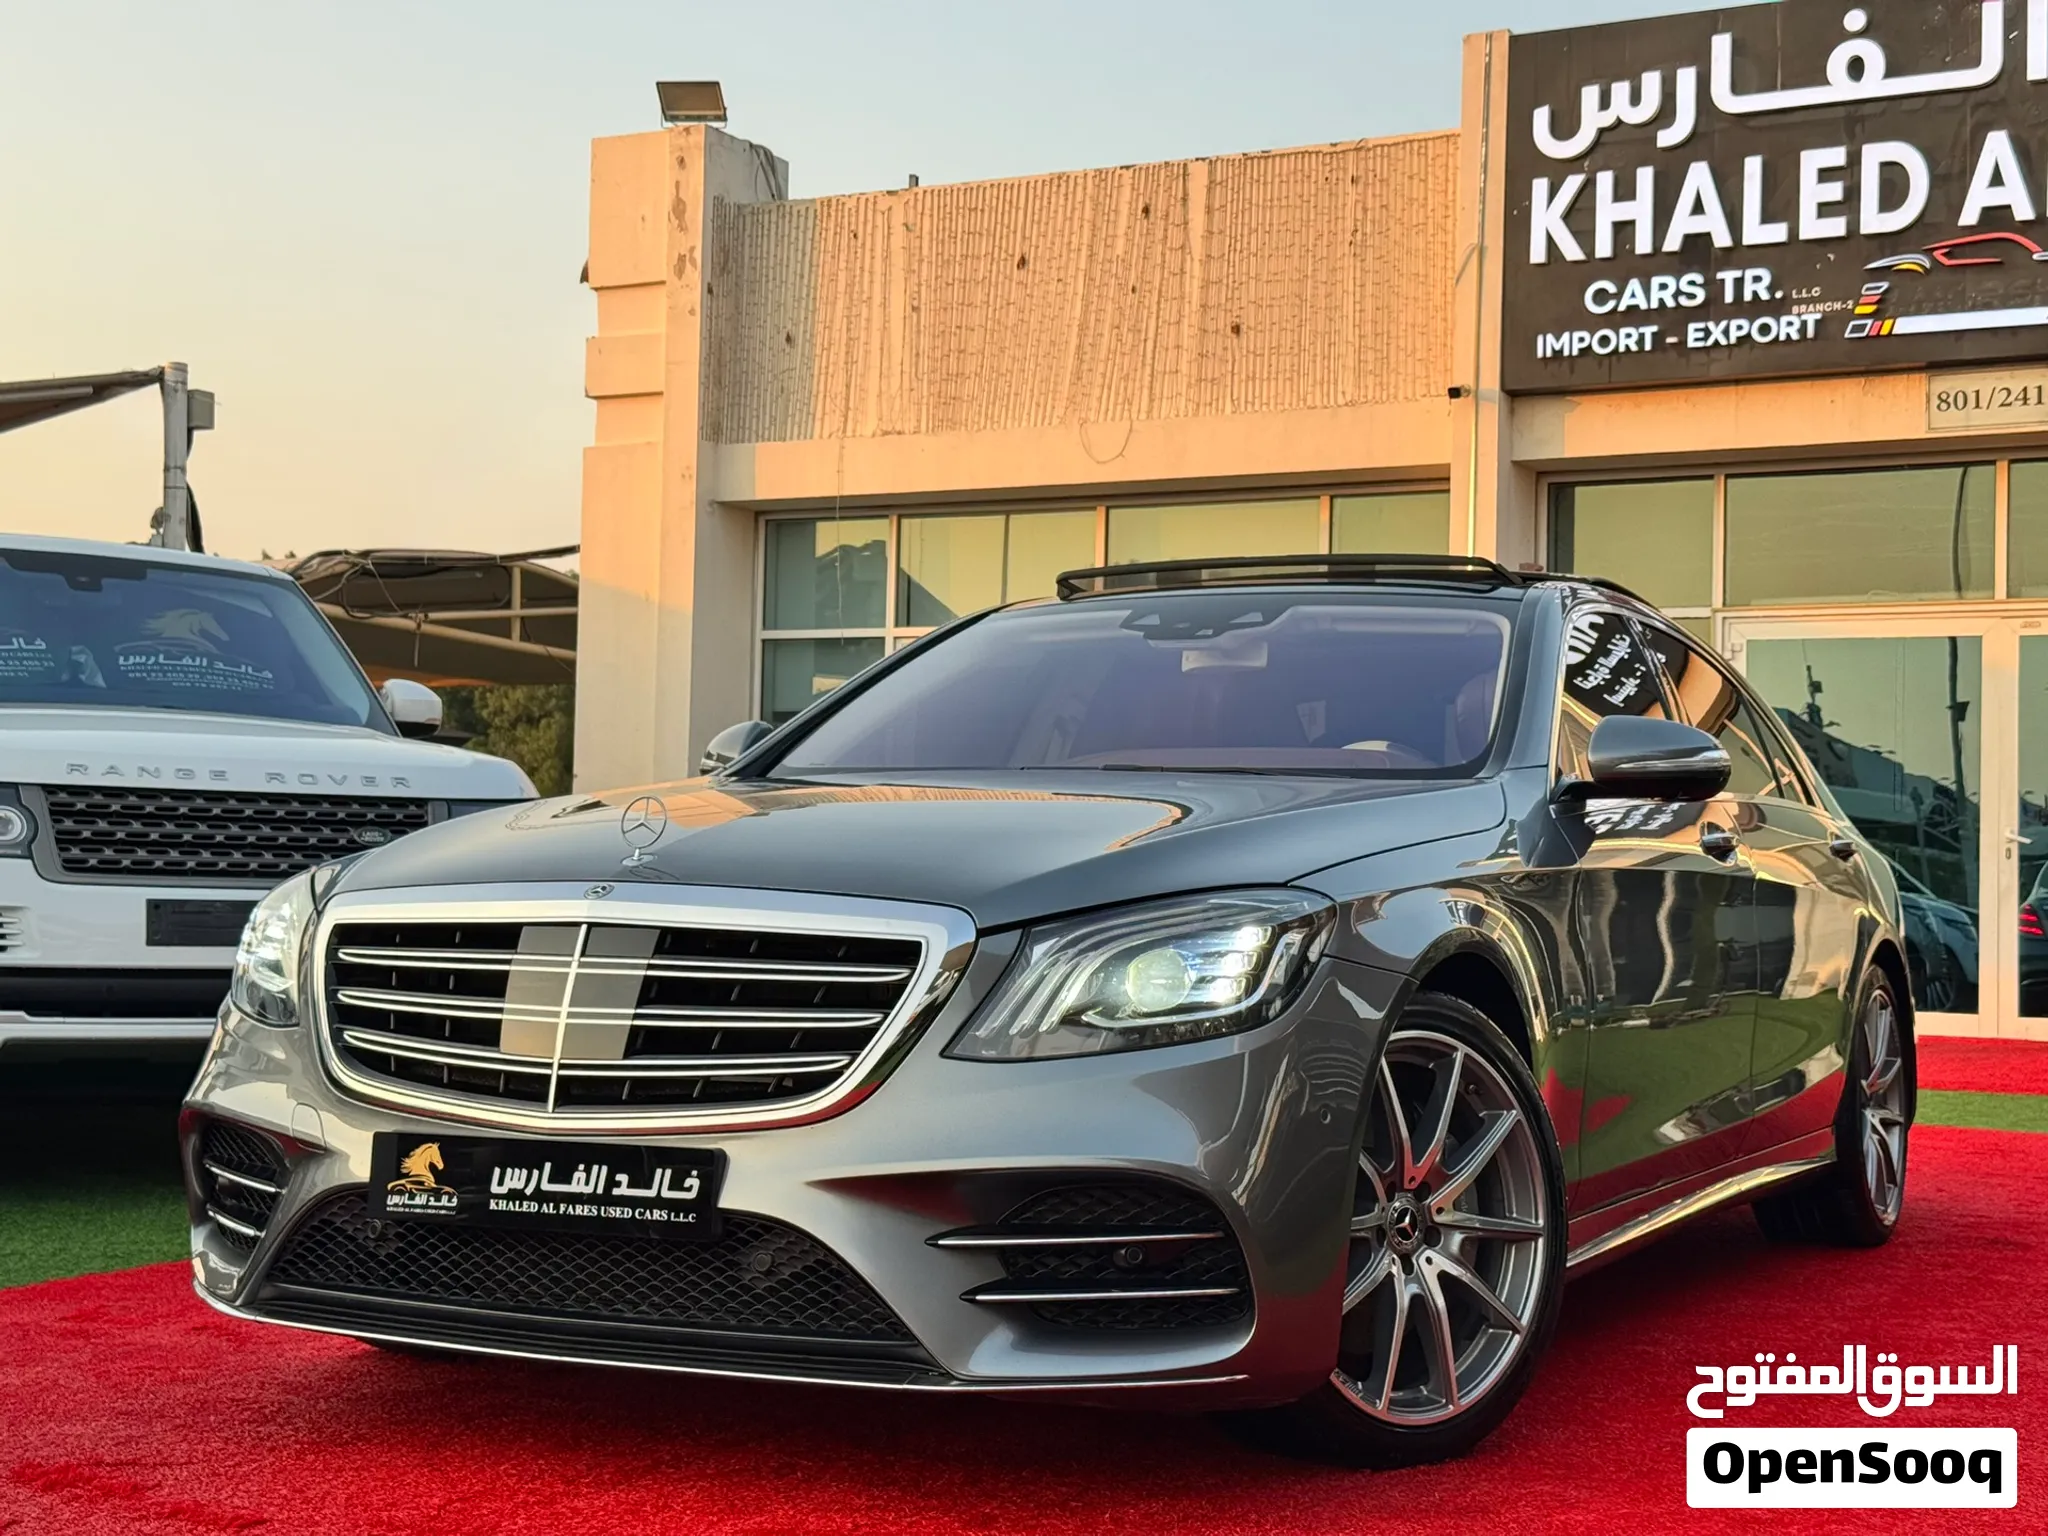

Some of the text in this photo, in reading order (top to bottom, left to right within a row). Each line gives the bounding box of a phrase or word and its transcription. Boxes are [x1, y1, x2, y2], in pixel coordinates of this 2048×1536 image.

[1528, 129, 2048, 265] KHALED A
[1583, 267, 1785, 315] CARS TR.
[1791, 285, 1822, 299] L.L.C
[1791, 299, 1855, 315] BRANCH-2
[1536, 325, 1658, 359] IMPORT
[1686, 313, 1823, 349] EXPORT
[1936, 384, 2045, 412] 801/241
[66, 762, 412, 789] RANGE ROVER
[489, 1161, 701, 1200] خالد الفارس
[489, 1199, 697, 1223] KHALED AL FARES USED CARS L.L.C
